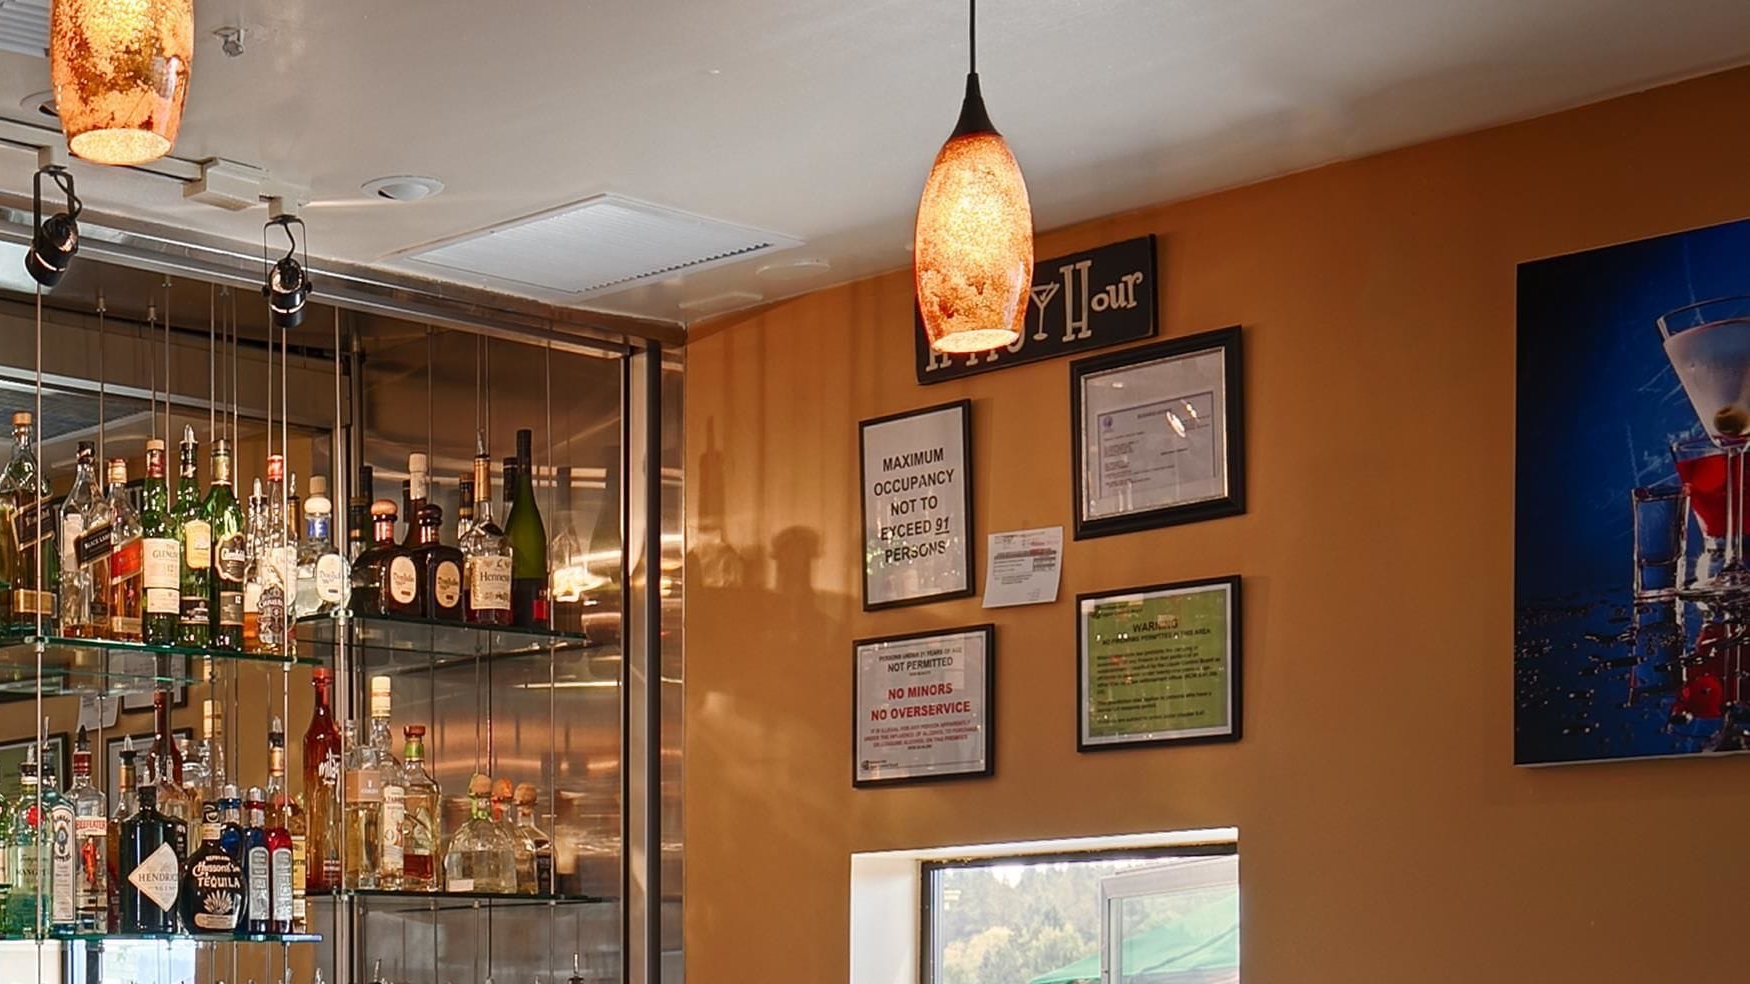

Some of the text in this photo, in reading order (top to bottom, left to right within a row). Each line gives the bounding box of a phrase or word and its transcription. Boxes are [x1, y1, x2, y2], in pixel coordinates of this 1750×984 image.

[1059, 260, 1144, 342] Hour
[883, 448, 944, 472] MAXIMUM
[874, 469, 954, 496] OCCUPANCY
[891, 496, 938, 516] NOT TO
[881, 517, 950, 541] EXCEED 91
[885, 541, 946, 563] PERSONS
[1133, 619, 1178, 633] WARNING
[887, 662, 904, 673] NOT
[907, 657, 953, 671] PERMITTED
[888, 683, 953, 700] NO MINORS
[870, 701, 971, 721] NO OVERSERVICE
[197, 876, 241, 888] TEQUILA
